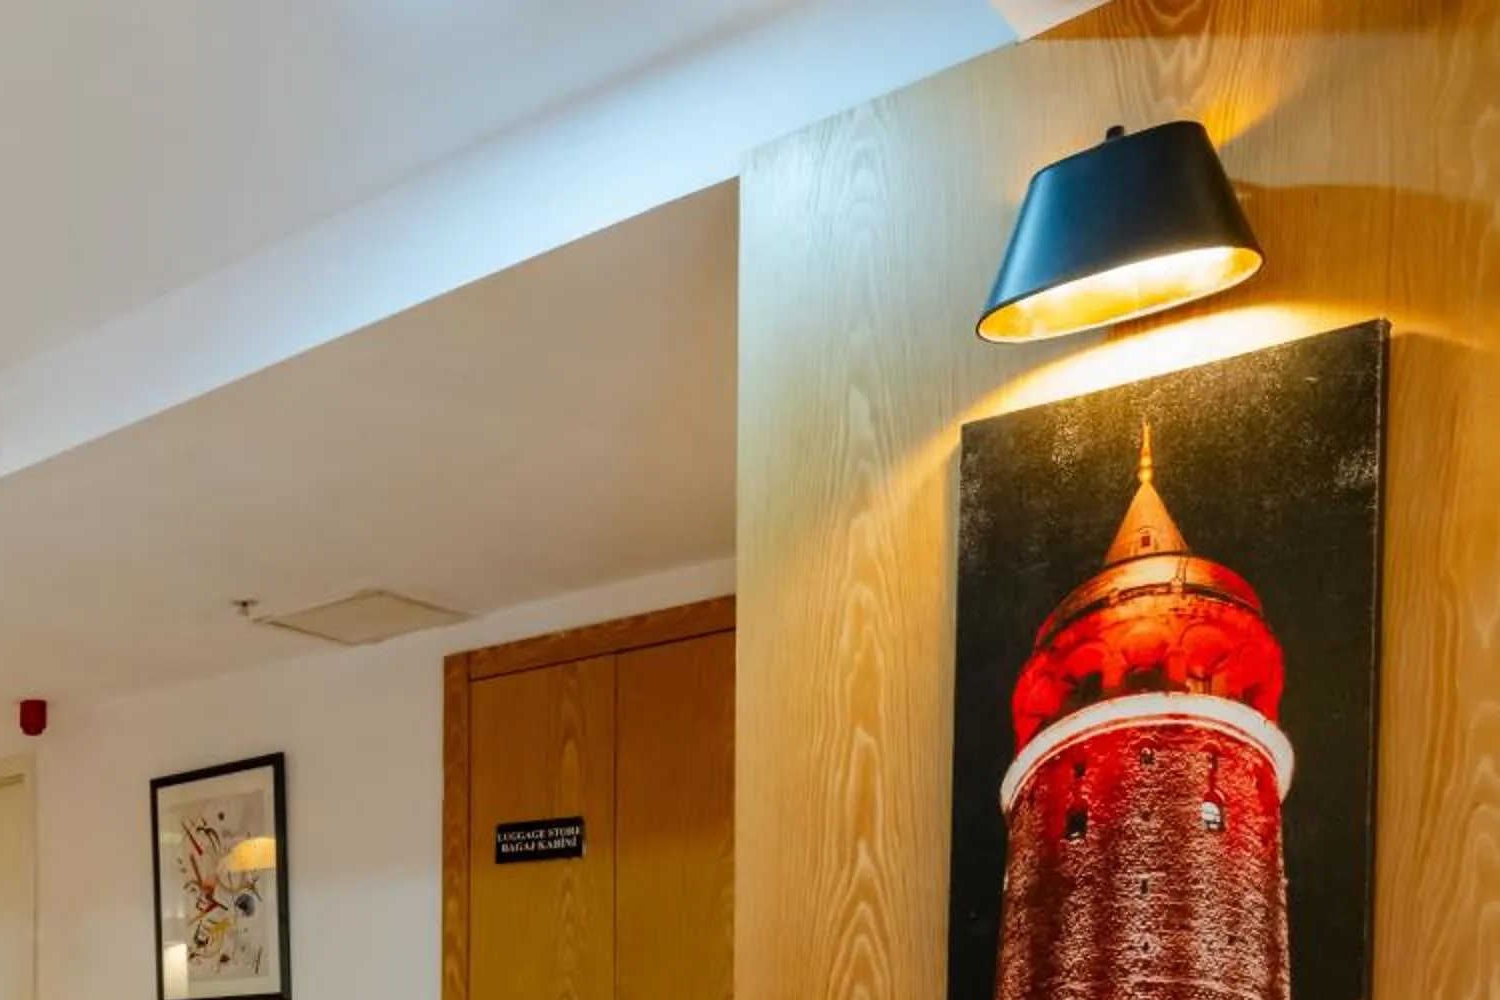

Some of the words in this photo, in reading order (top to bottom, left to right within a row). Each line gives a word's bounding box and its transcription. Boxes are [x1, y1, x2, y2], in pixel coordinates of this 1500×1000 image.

[498, 829, 546, 842] LUGGAGE
[548, 826, 580, 837] STORE
[501, 842, 535, 853] BAGAJ
